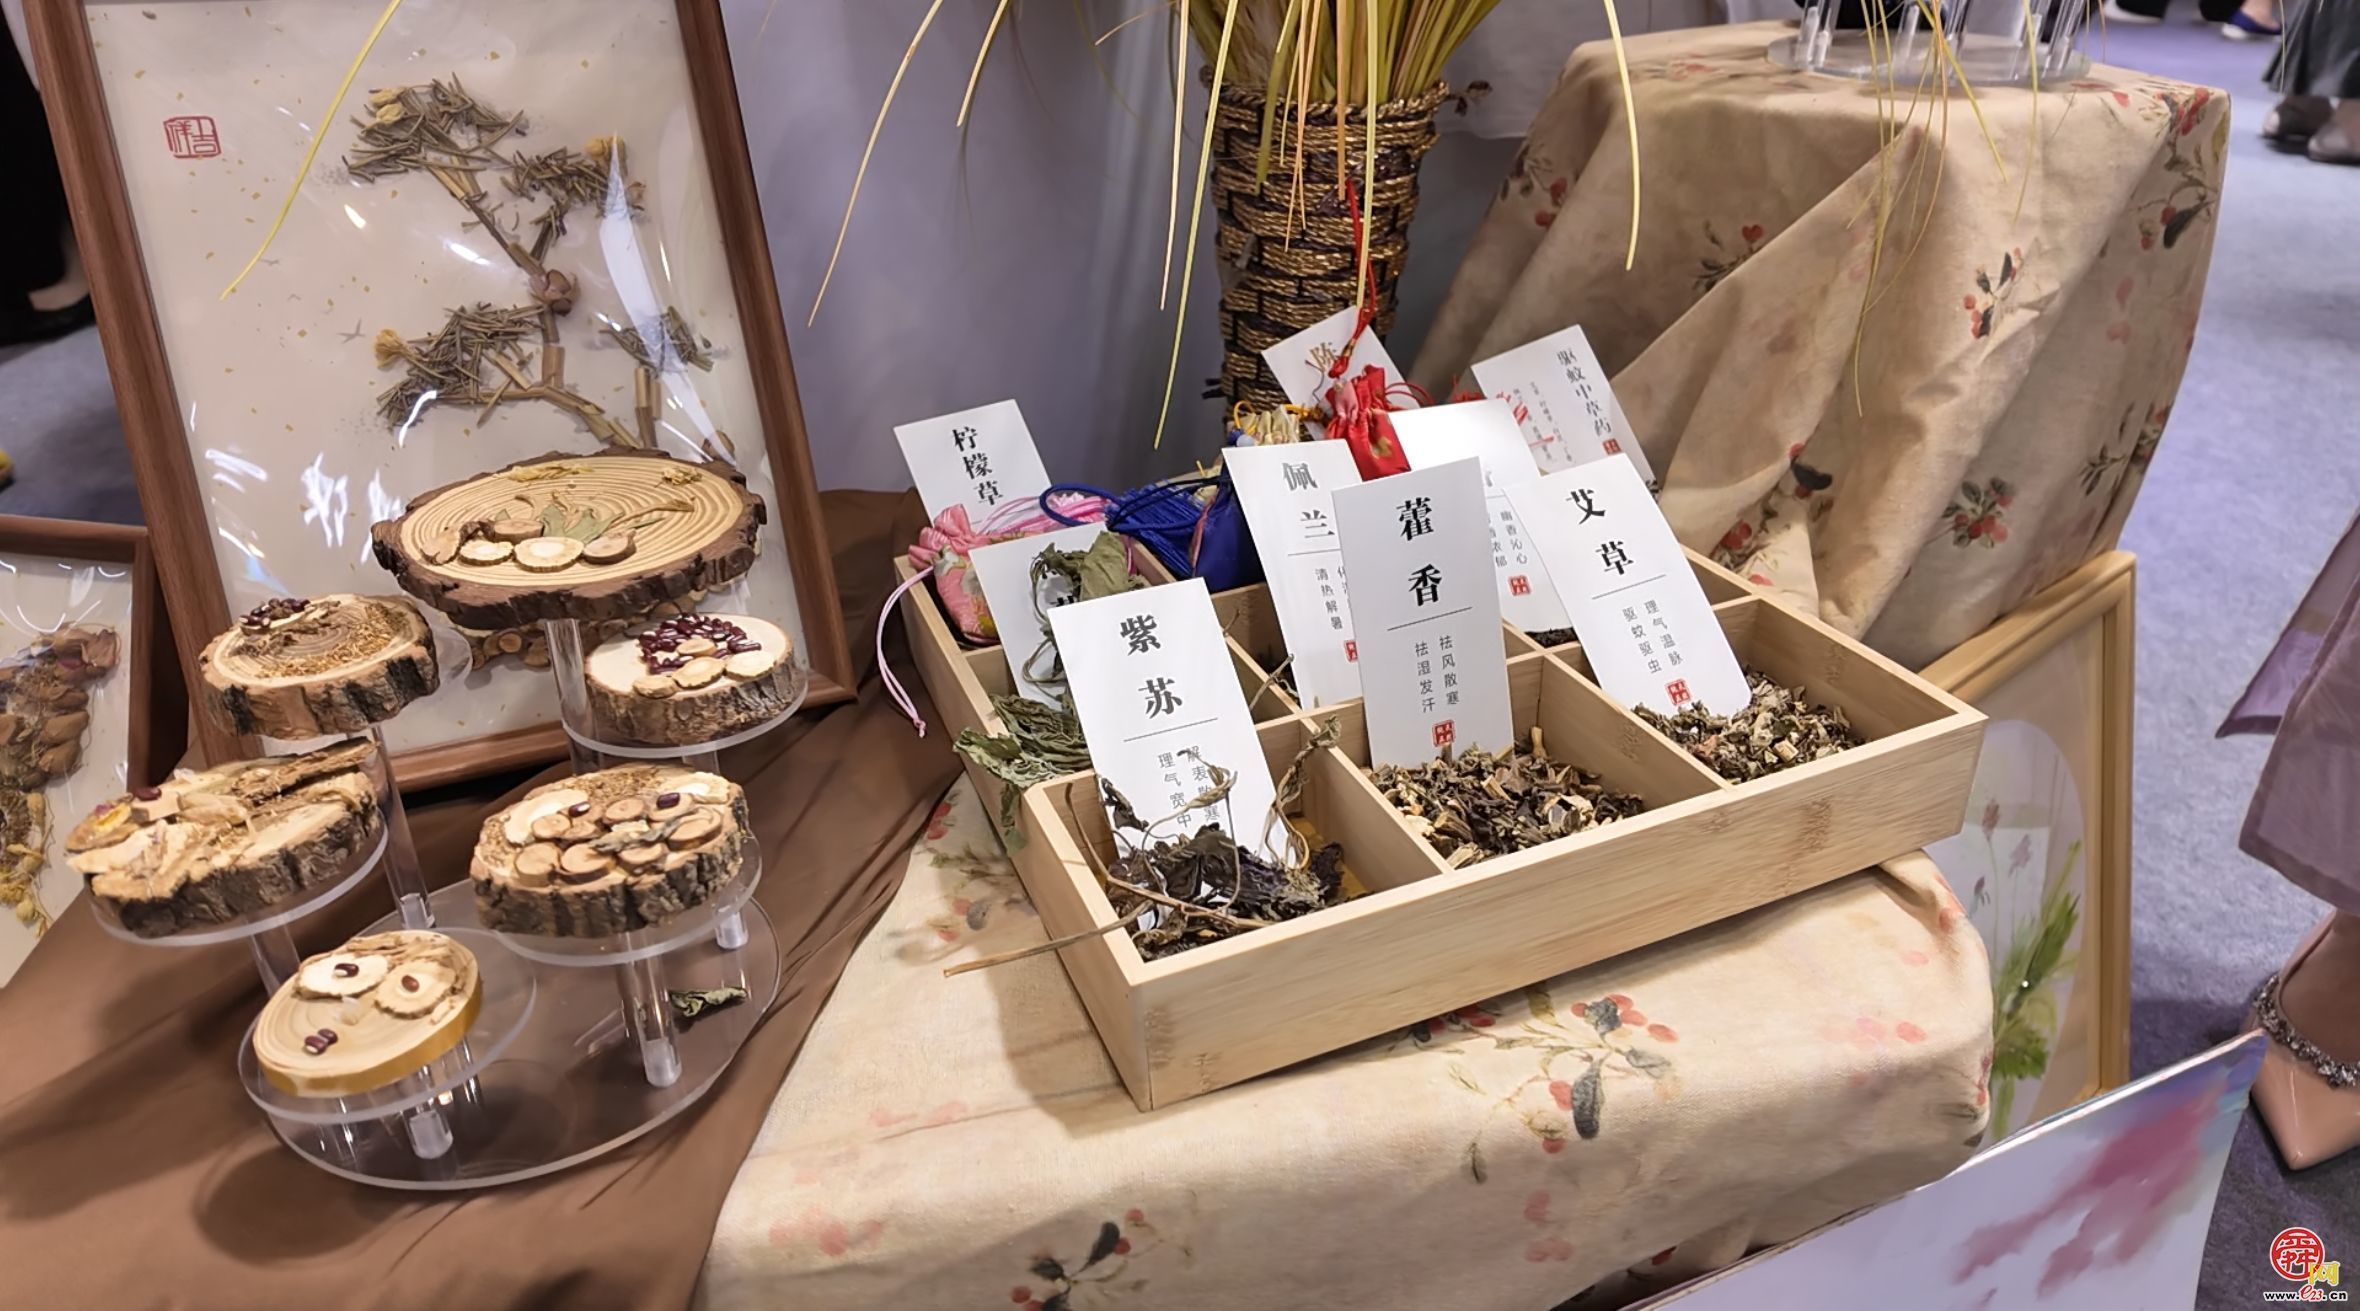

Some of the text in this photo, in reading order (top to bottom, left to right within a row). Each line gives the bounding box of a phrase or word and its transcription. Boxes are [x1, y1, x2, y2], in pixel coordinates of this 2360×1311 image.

[952, 426, 1003, 506] 柠檬草
[1282, 462, 1336, 539] 佩兰
[1396, 497, 1443, 607] 藿香
[1500, 511, 1529, 565] 幽香沁心
[1566, 488, 1634, 576] 艾草
[1314, 567, 1343, 630] 清热解暑
[1644, 599, 1684, 667] 理气温脉
[1120, 613, 1183, 720] 紫苏
[1414, 640, 1436, 714] 祛湿发汗
[1622, 605, 1663, 674] 驱蚊驱虫
[1158, 751, 1192, 828] 理气宽中
